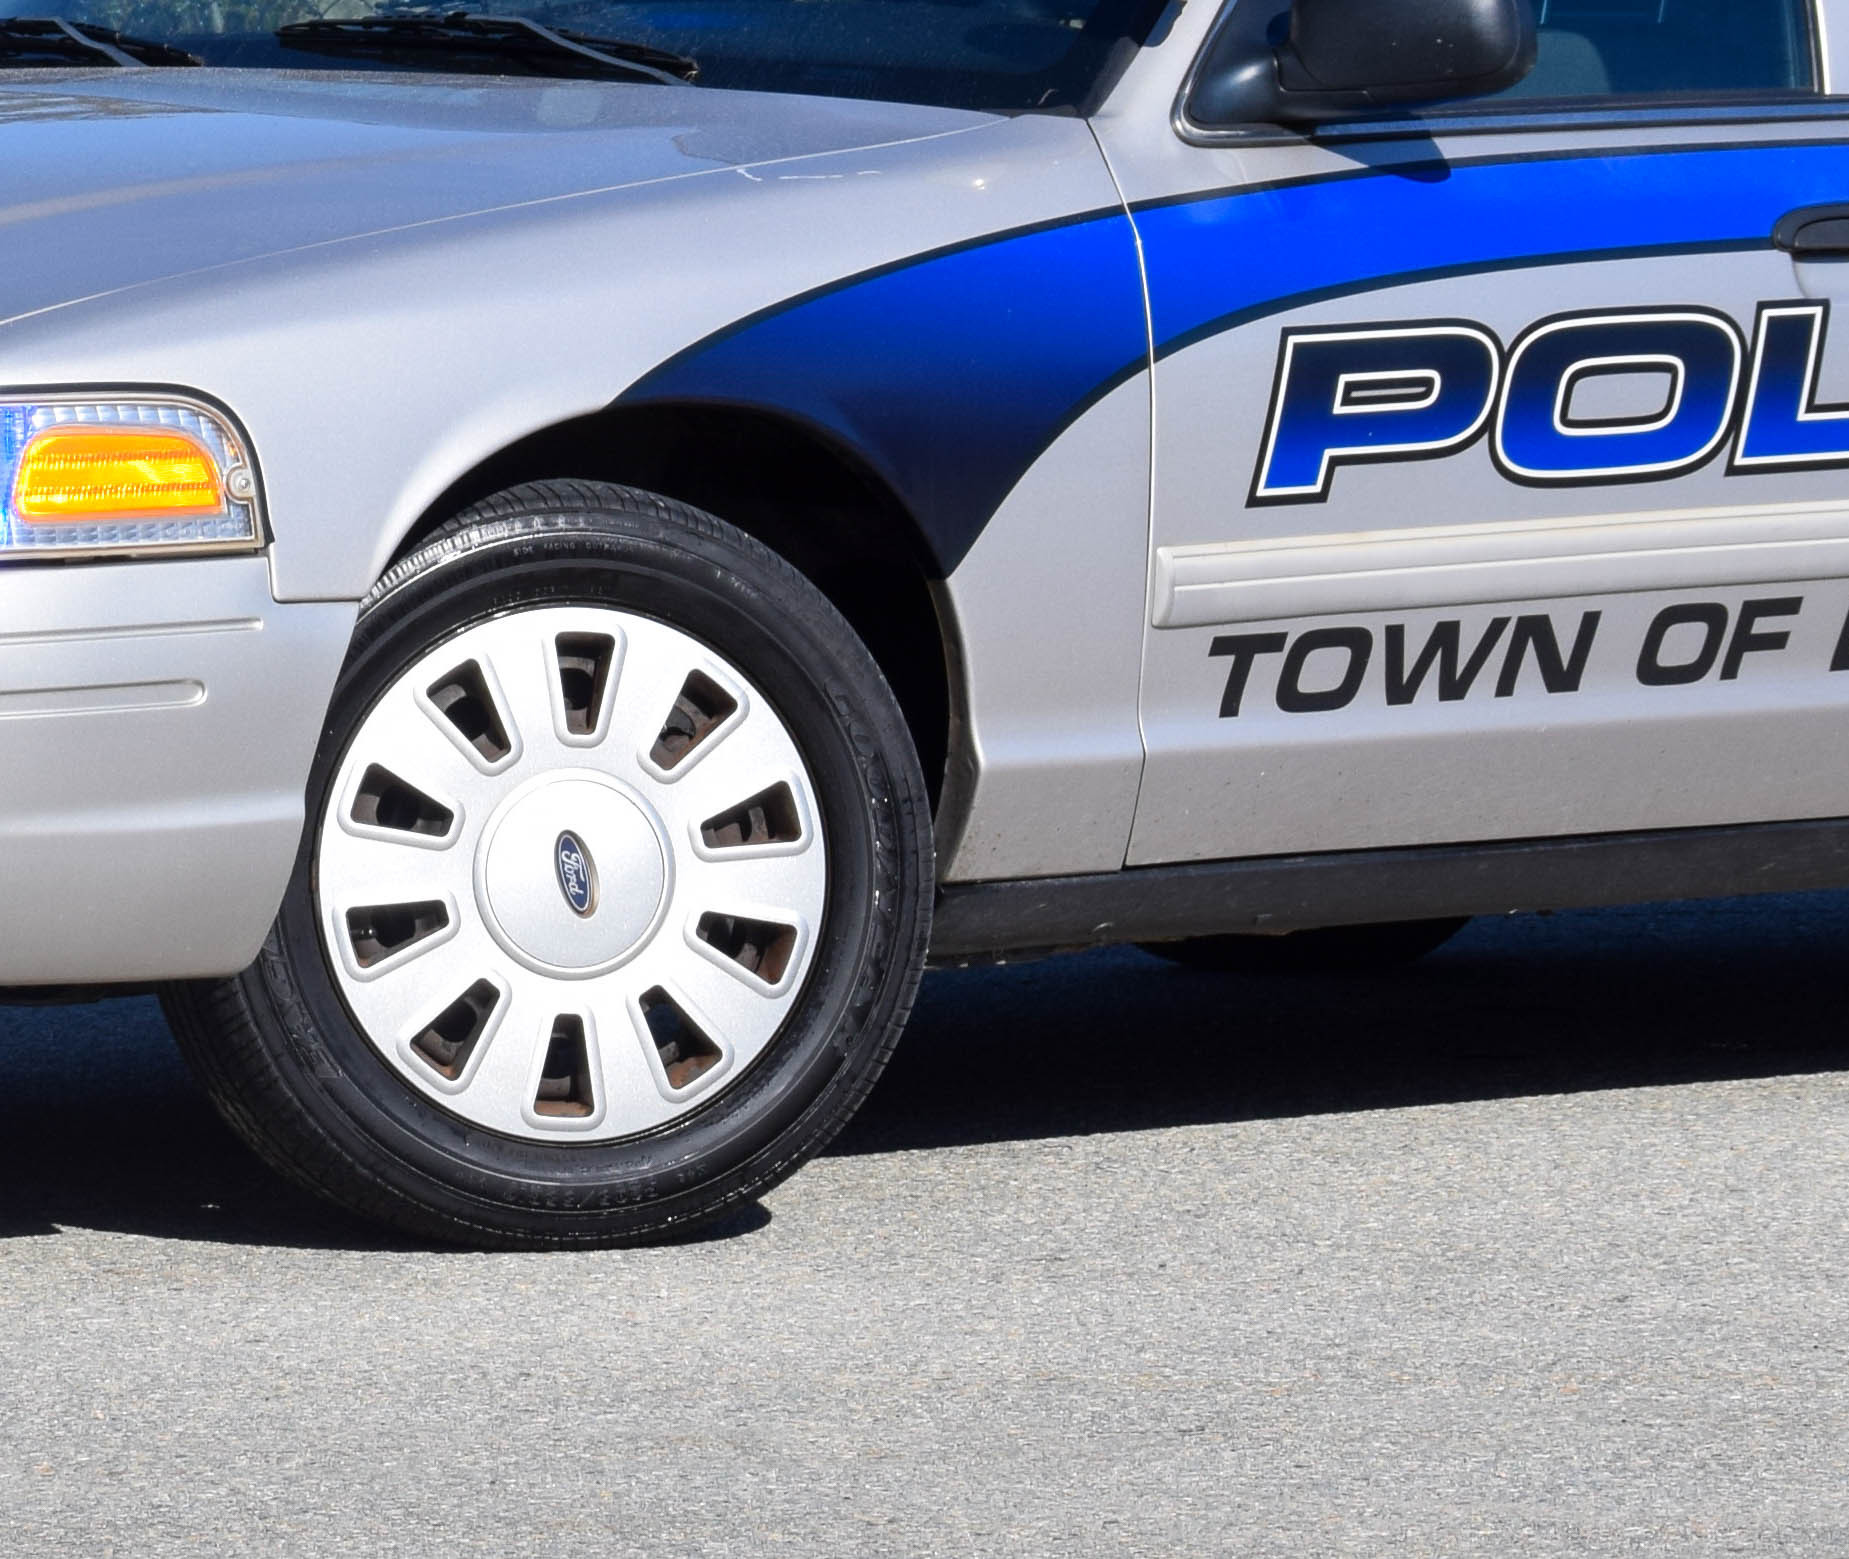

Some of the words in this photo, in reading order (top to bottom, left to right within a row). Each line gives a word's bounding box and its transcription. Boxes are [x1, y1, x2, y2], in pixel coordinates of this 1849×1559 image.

[1208, 610, 1603, 718] TOWN
[1636, 596, 1804, 687] OF
[561, 849, 586, 896] Ford
